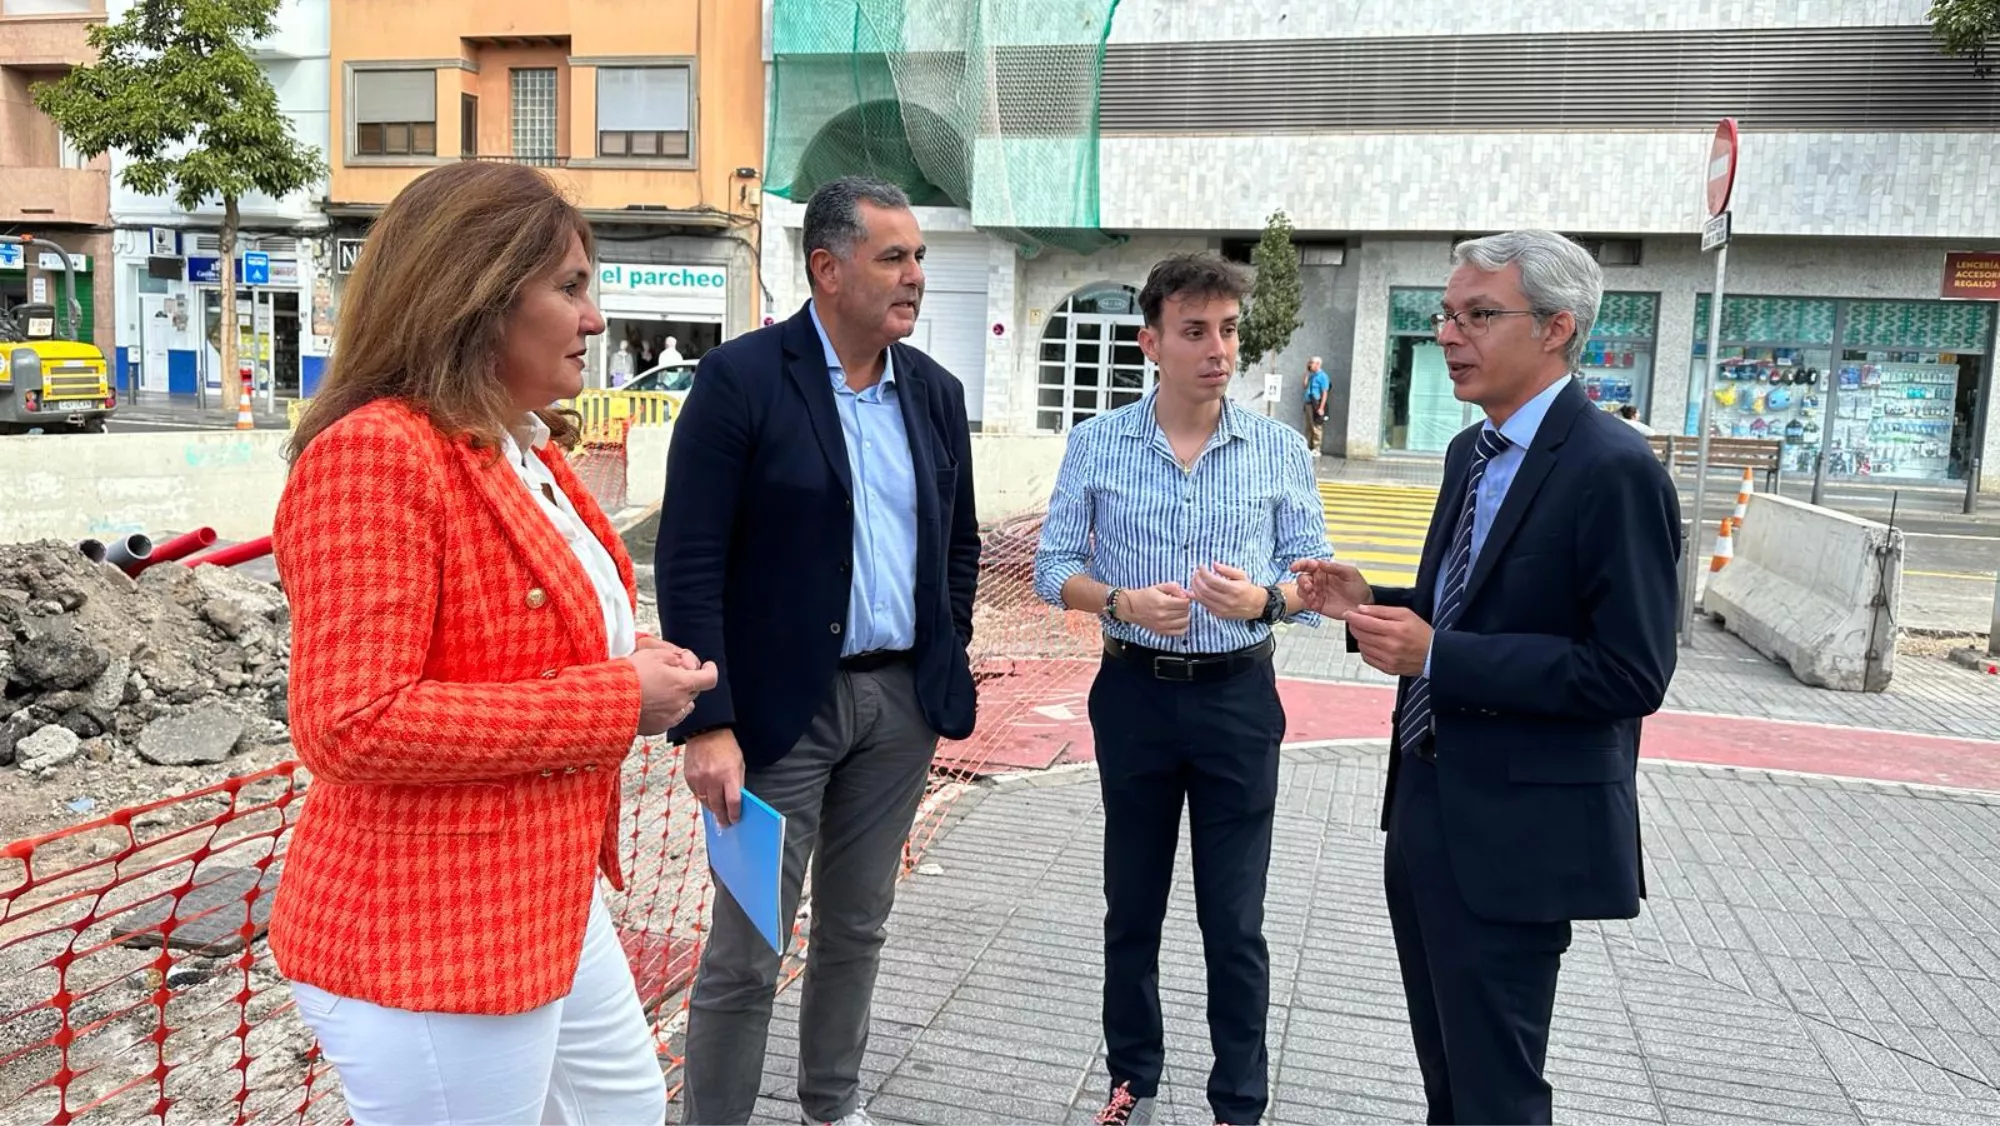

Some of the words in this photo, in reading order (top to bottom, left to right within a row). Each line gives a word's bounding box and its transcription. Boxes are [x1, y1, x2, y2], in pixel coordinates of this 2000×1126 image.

[602, 266, 621, 284] el
[630, 268, 725, 289] parcheo
[1953, 280, 1998, 288] REGALOS
